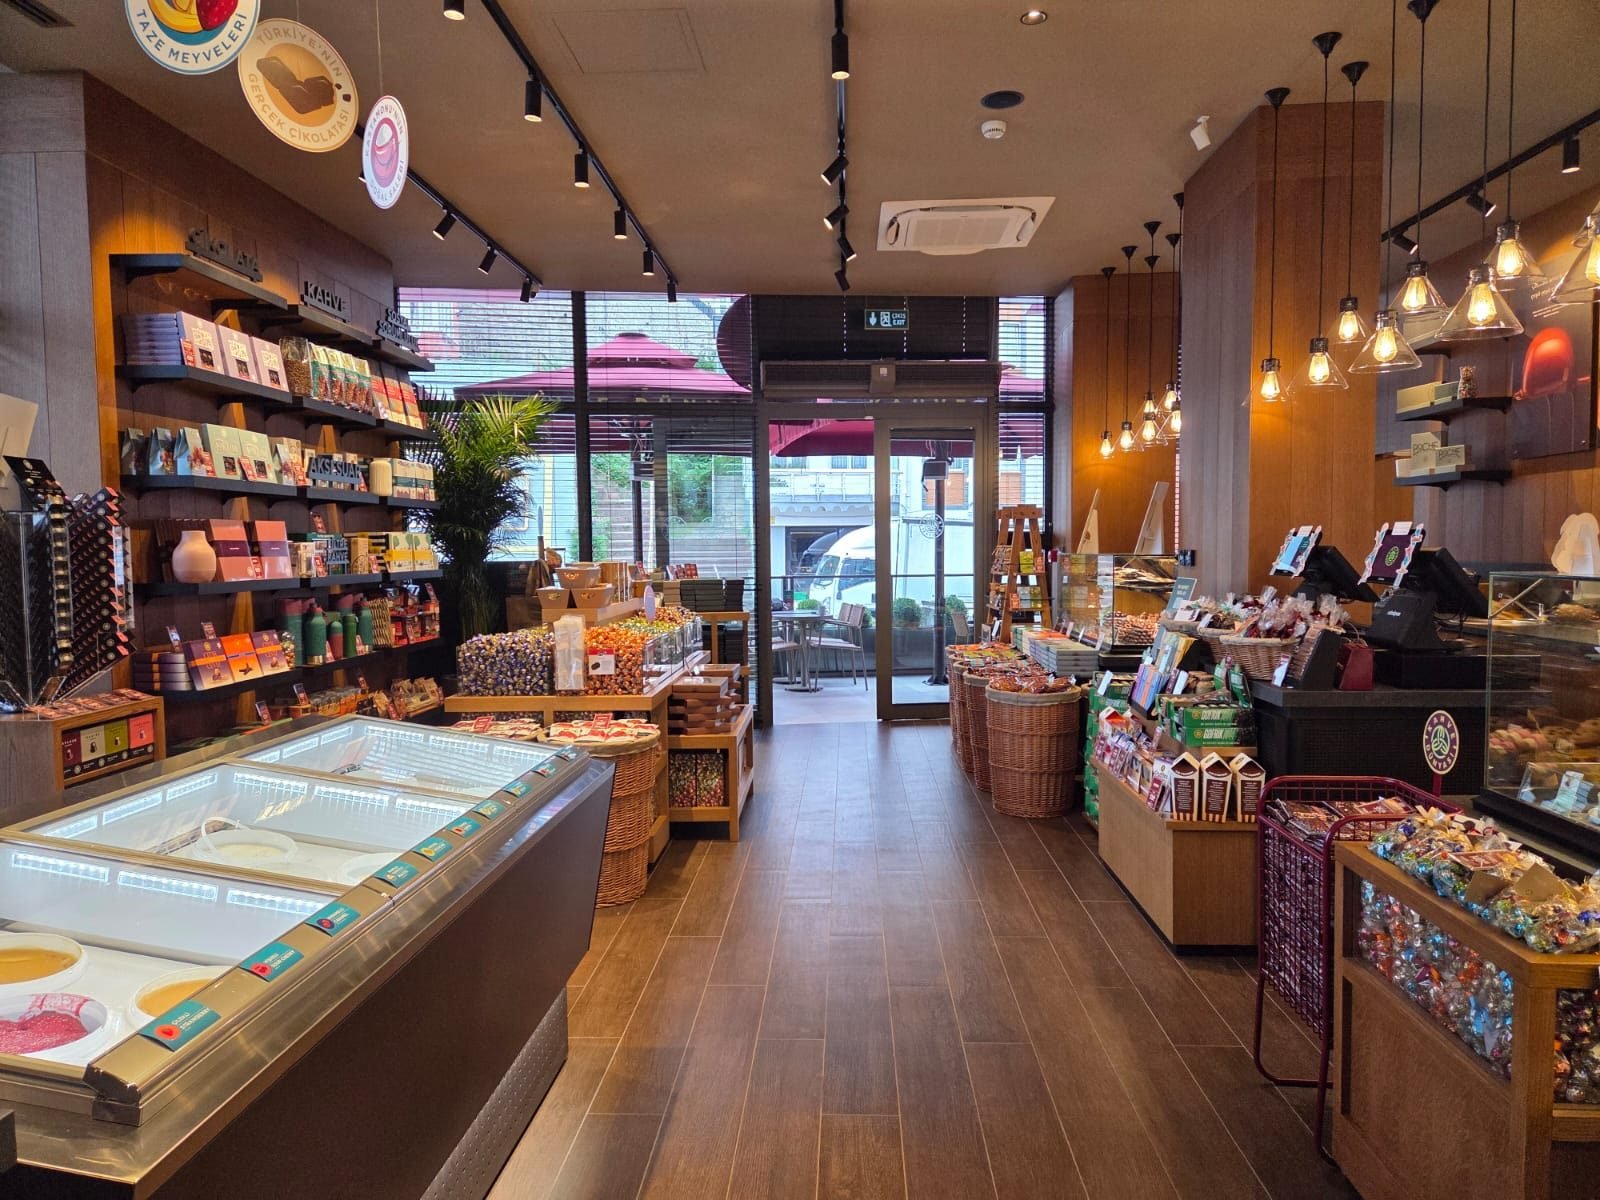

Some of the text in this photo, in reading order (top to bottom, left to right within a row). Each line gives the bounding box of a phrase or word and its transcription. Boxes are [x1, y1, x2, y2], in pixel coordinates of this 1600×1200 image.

[136, 9, 247, 64] TAZE MEYVELERİ
[248, 26, 351, 143] TÜRKİYE'NİN GERÇEK ÇİKOLATASI
[303, 281, 350, 314] KAHVE
[310, 457, 361, 478] AKSESUAR
[1426, 715, 1456, 769] KAHVE DÜNYASI
